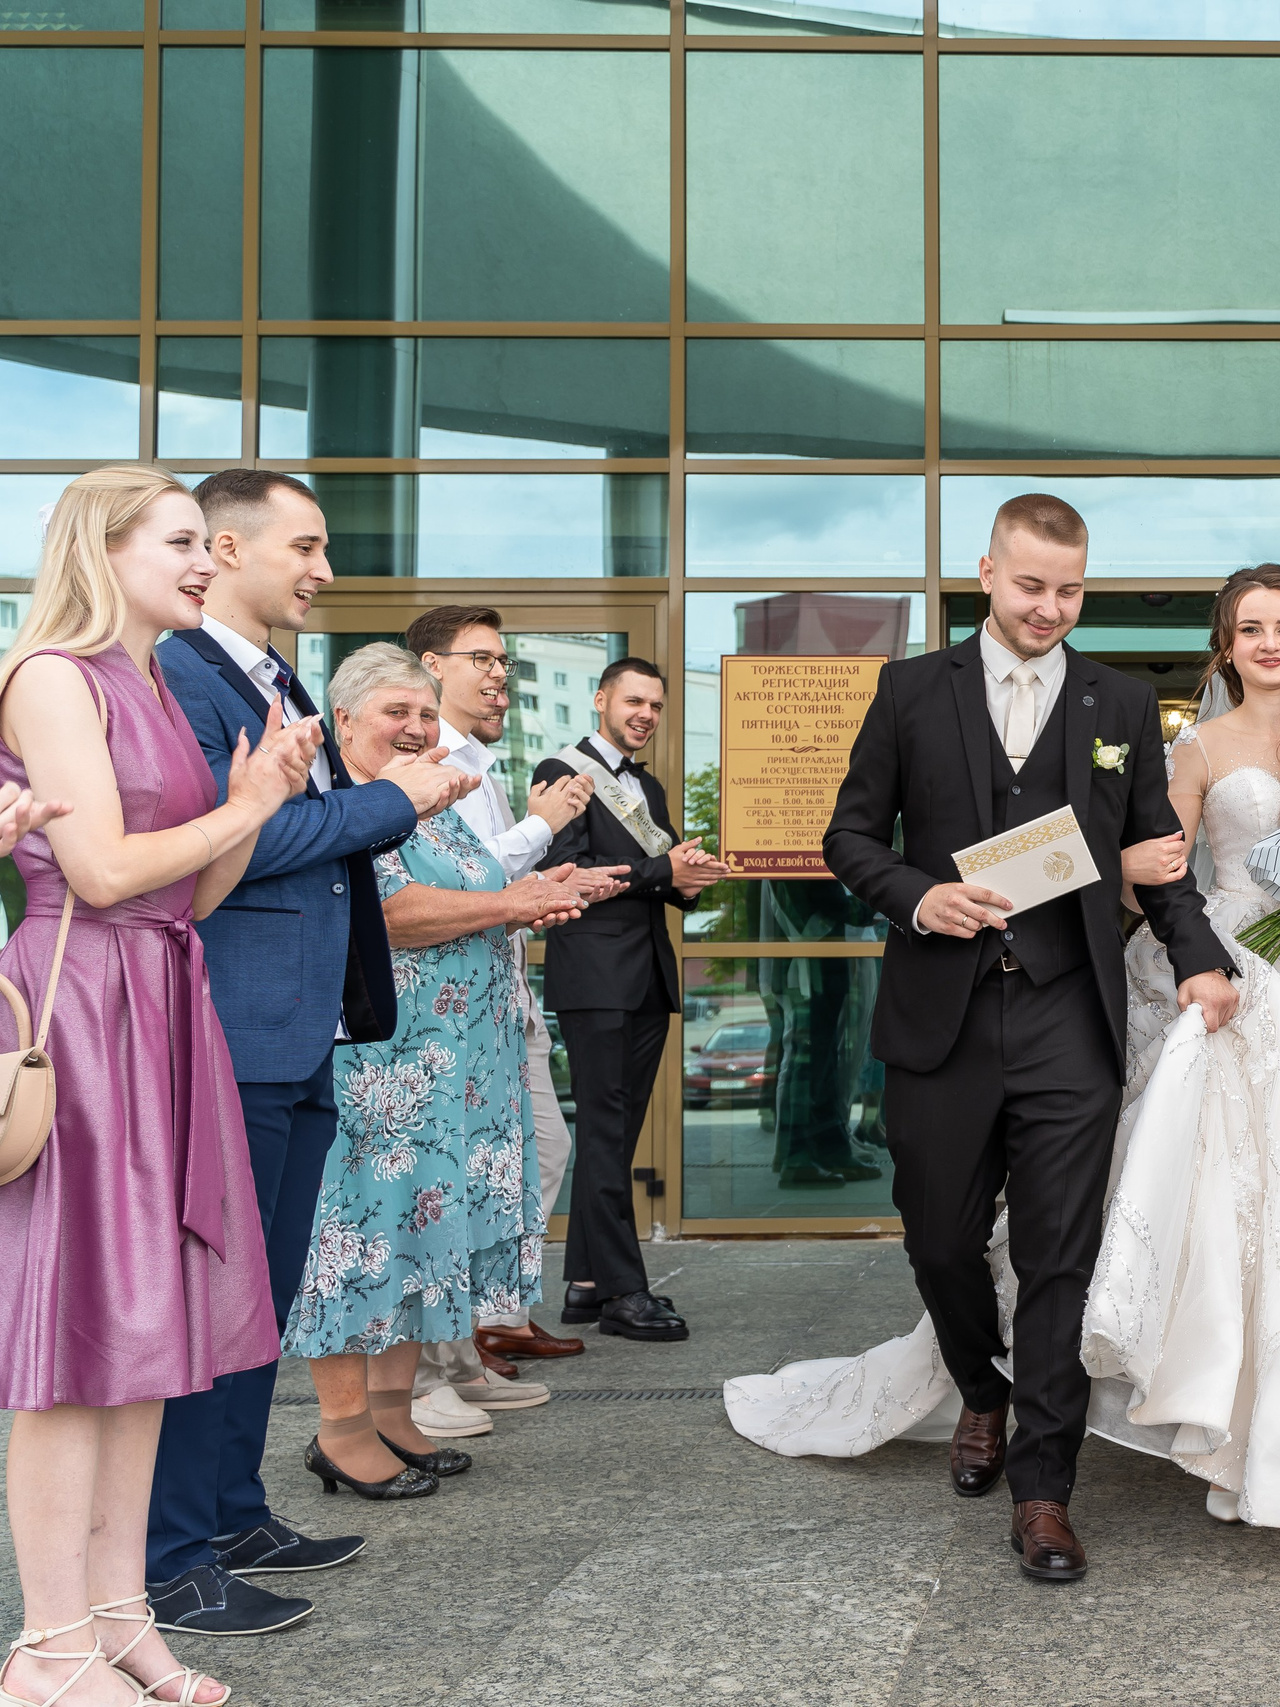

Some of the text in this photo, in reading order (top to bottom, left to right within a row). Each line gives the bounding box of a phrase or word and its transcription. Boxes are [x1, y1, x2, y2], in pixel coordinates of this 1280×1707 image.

[751, 665, 860, 675] ТОРЖЕСТВЕННАЯ
[762, 678, 849, 690] РЕГИСТРАЦИЯ
[734, 691, 876, 702] АКТОВ ГРАЖДАНСКОГО
[766, 704, 845, 714] СОСТОЯНИЯ:
[741, 719, 800, 731] ПЯТНИЦА
[815, 719, 862, 729] СУББОТ
[771, 734, 798, 744] 10.00
[813, 734, 839, 744] 16.00
[800, 757, 843, 765] ГРАЖДАН
[729, 777, 828, 785] АДМИНИСТРАТИВНЫХ
[746, 810, 776, 818] СРЕДА,
[779, 810, 818, 818] ЧЕТВЕРГ,
[743, 855, 825, 868] ВХОД С ЛЕВОЙ СТОР
